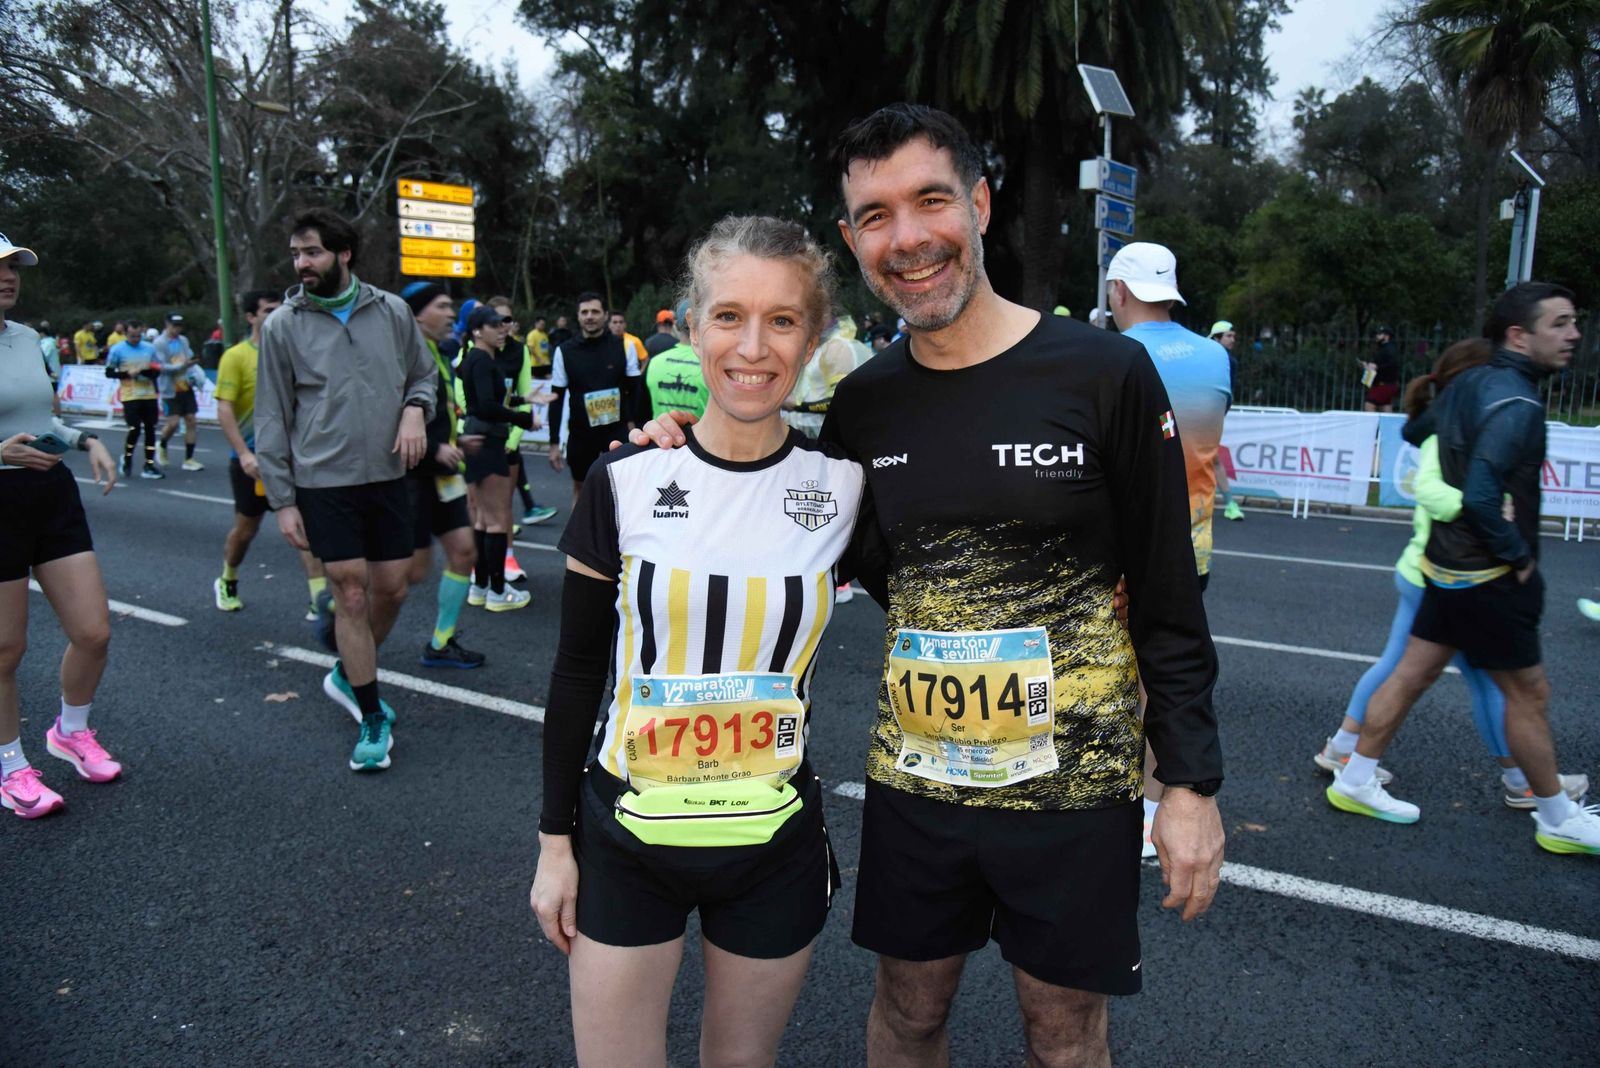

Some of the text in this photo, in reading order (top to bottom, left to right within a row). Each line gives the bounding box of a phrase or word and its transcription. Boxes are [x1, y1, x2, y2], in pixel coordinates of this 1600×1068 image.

[992, 443, 1084, 467] TECH
[1235, 442, 1354, 475] CREATE
[1035, 469, 1083, 479] friendly
[1542, 459, 1600, 489] ATE
[1565, 496, 1600, 507] Evento
[653, 509, 689, 519] luanvi
[934, 637, 987, 649] maratón
[943, 647, 989, 659] sevilla
[681, 678, 744, 692] maratón
[696, 686, 745, 701] sevilla
[900, 670, 1025, 721] 17914
[951, 723, 965, 732] Ser
[639, 711, 775, 758] 17913
[697, 760, 719, 769] Barb
[703, 774, 729, 782] Monte
[731, 771, 752, 779] Grao
[946, 767, 968, 777] HOKA
